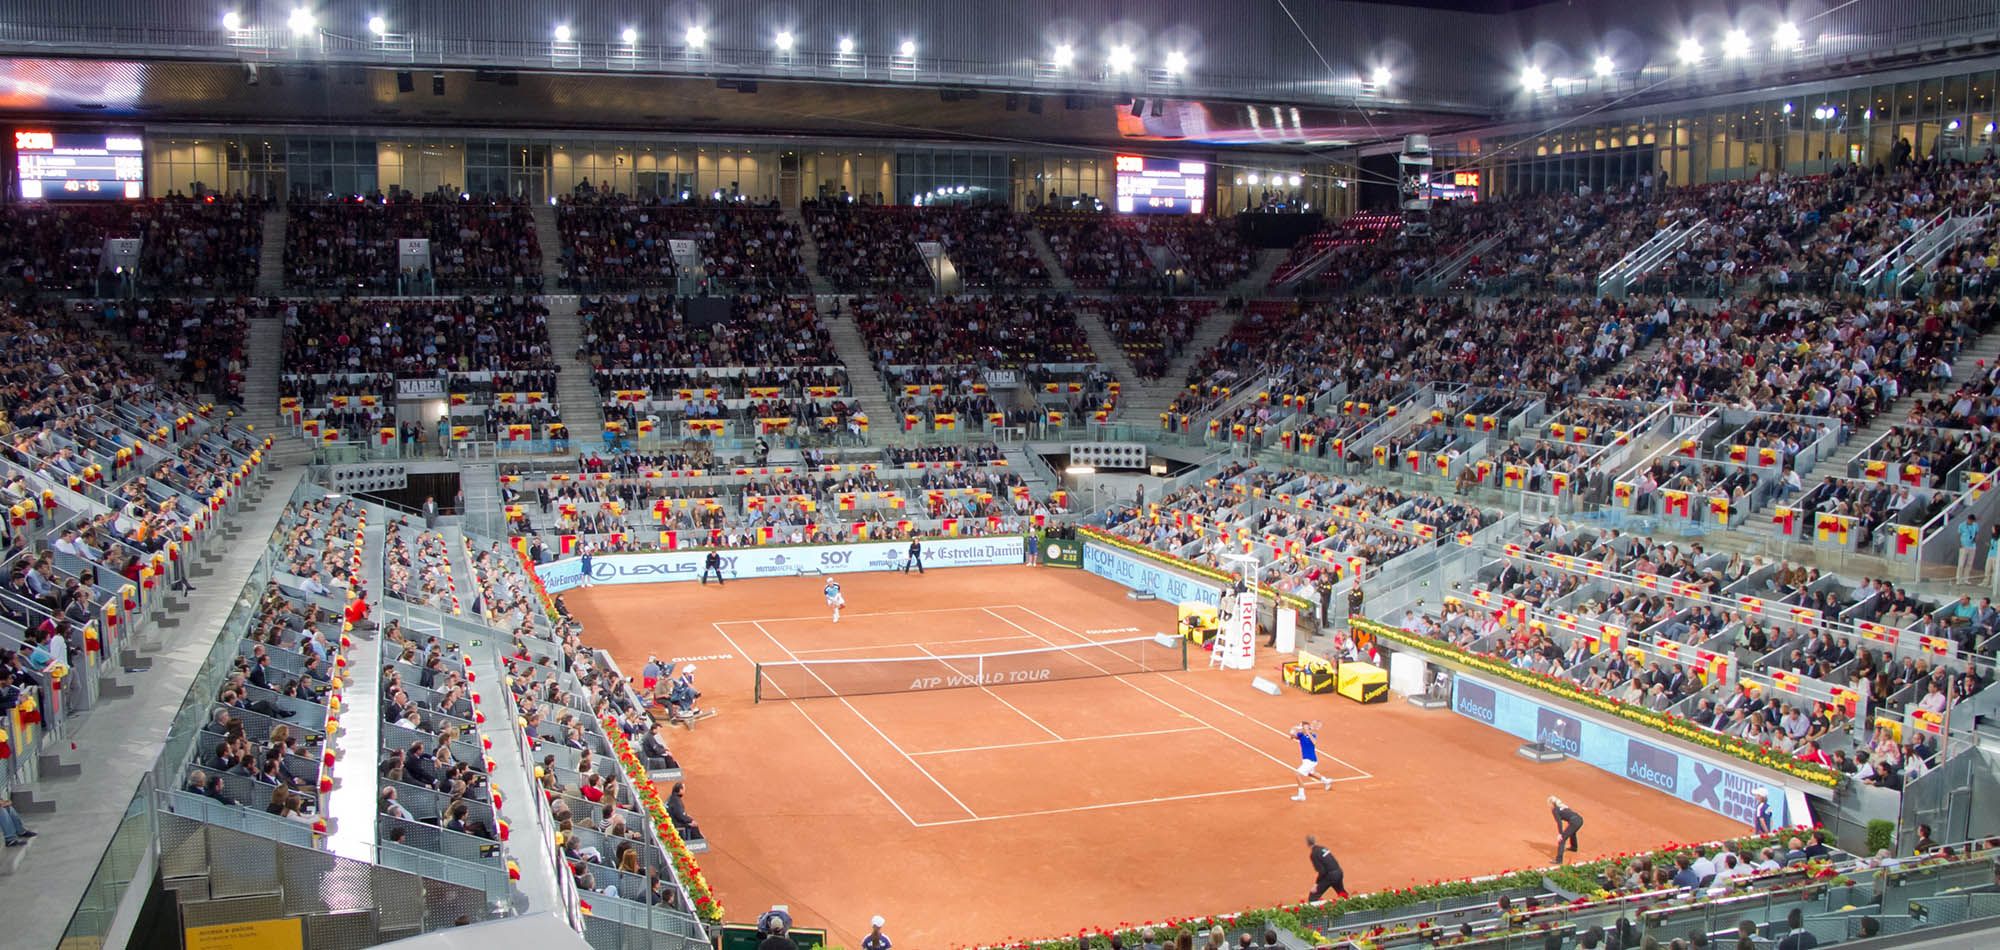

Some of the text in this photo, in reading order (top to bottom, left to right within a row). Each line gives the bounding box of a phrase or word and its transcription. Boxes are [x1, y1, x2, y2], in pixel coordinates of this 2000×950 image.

[399, 380, 443, 393] MARCA
[820, 550, 853, 565] SOY
[938, 545, 1023, 560] Estrella Damm
[1085, 546, 1114, 569] RICOH
[619, 562, 698, 576] LEXUS
[1116, 560, 1135, 580] ABC
[1167, 578, 1188, 599] ABC
[1242, 602, 1252, 657] RICOH
[910, 668, 1051, 690] ATP WORLD TOUR
[1459, 697, 1493, 721] Adecco
[1629, 759, 1674, 789] Adecco
